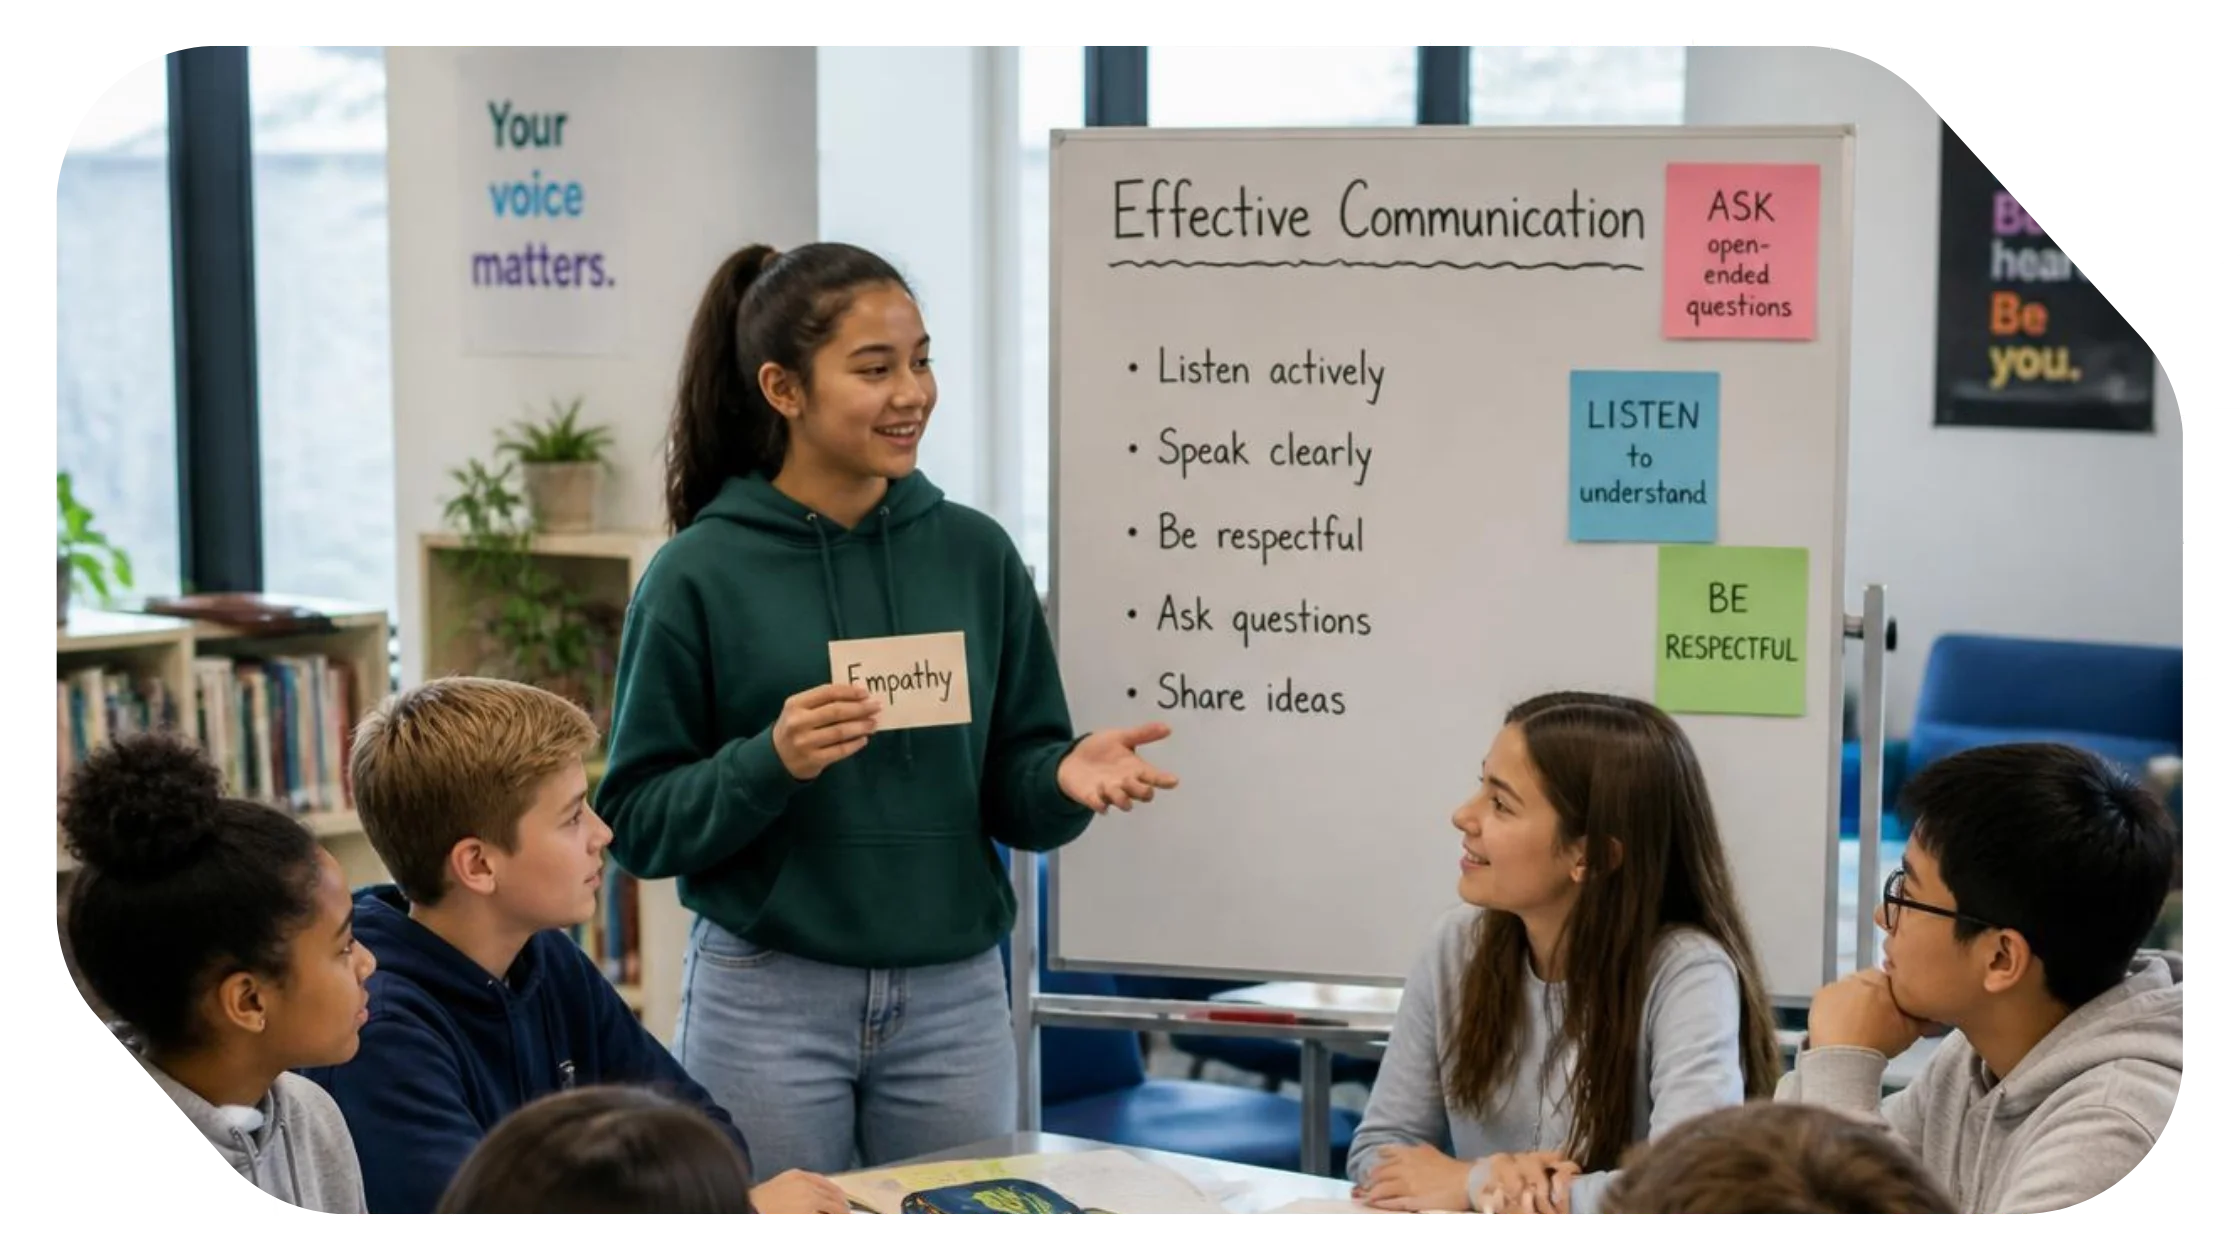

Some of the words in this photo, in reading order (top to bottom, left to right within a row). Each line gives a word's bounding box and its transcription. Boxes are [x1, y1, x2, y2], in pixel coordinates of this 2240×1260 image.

[487, 99, 568, 149] Your
[488, 168, 583, 217] voice
[1114, 179, 1312, 239] Effective
[1339, 179, 1645, 239] Communication
[1707, 188, 1776, 222] ASK
[471, 241, 616, 287] matters.
[1707, 238, 1770, 263] open-
[1991, 238, 2090, 283] hear
[1704, 263, 1770, 285] ended
[1686, 292, 1793, 327] questions
[1992, 292, 2048, 336] Be
[1159, 346, 1250, 384] Listen
[1269, 348, 1385, 405] actively
[1990, 347, 2082, 388] you.
[1588, 400, 1700, 429] LISTEN
[1158, 426, 1250, 480] Speak
[1269, 430, 1373, 486] clearly
[1626, 444, 1653, 468] to
[1580, 479, 1707, 505] understand
[1158, 511, 1197, 550] Be
[1217, 513, 1364, 566] respectful
[1708, 581, 1749, 614] BE
[1156, 593, 1214, 632] Ask
[1232, 598, 1373, 648] questions
[1665, 633, 1799, 662] RESPECTFUL
[847, 659, 952, 706] Empathy
[1156, 671, 1246, 712] Share
[1266, 676, 1347, 715] ideas
